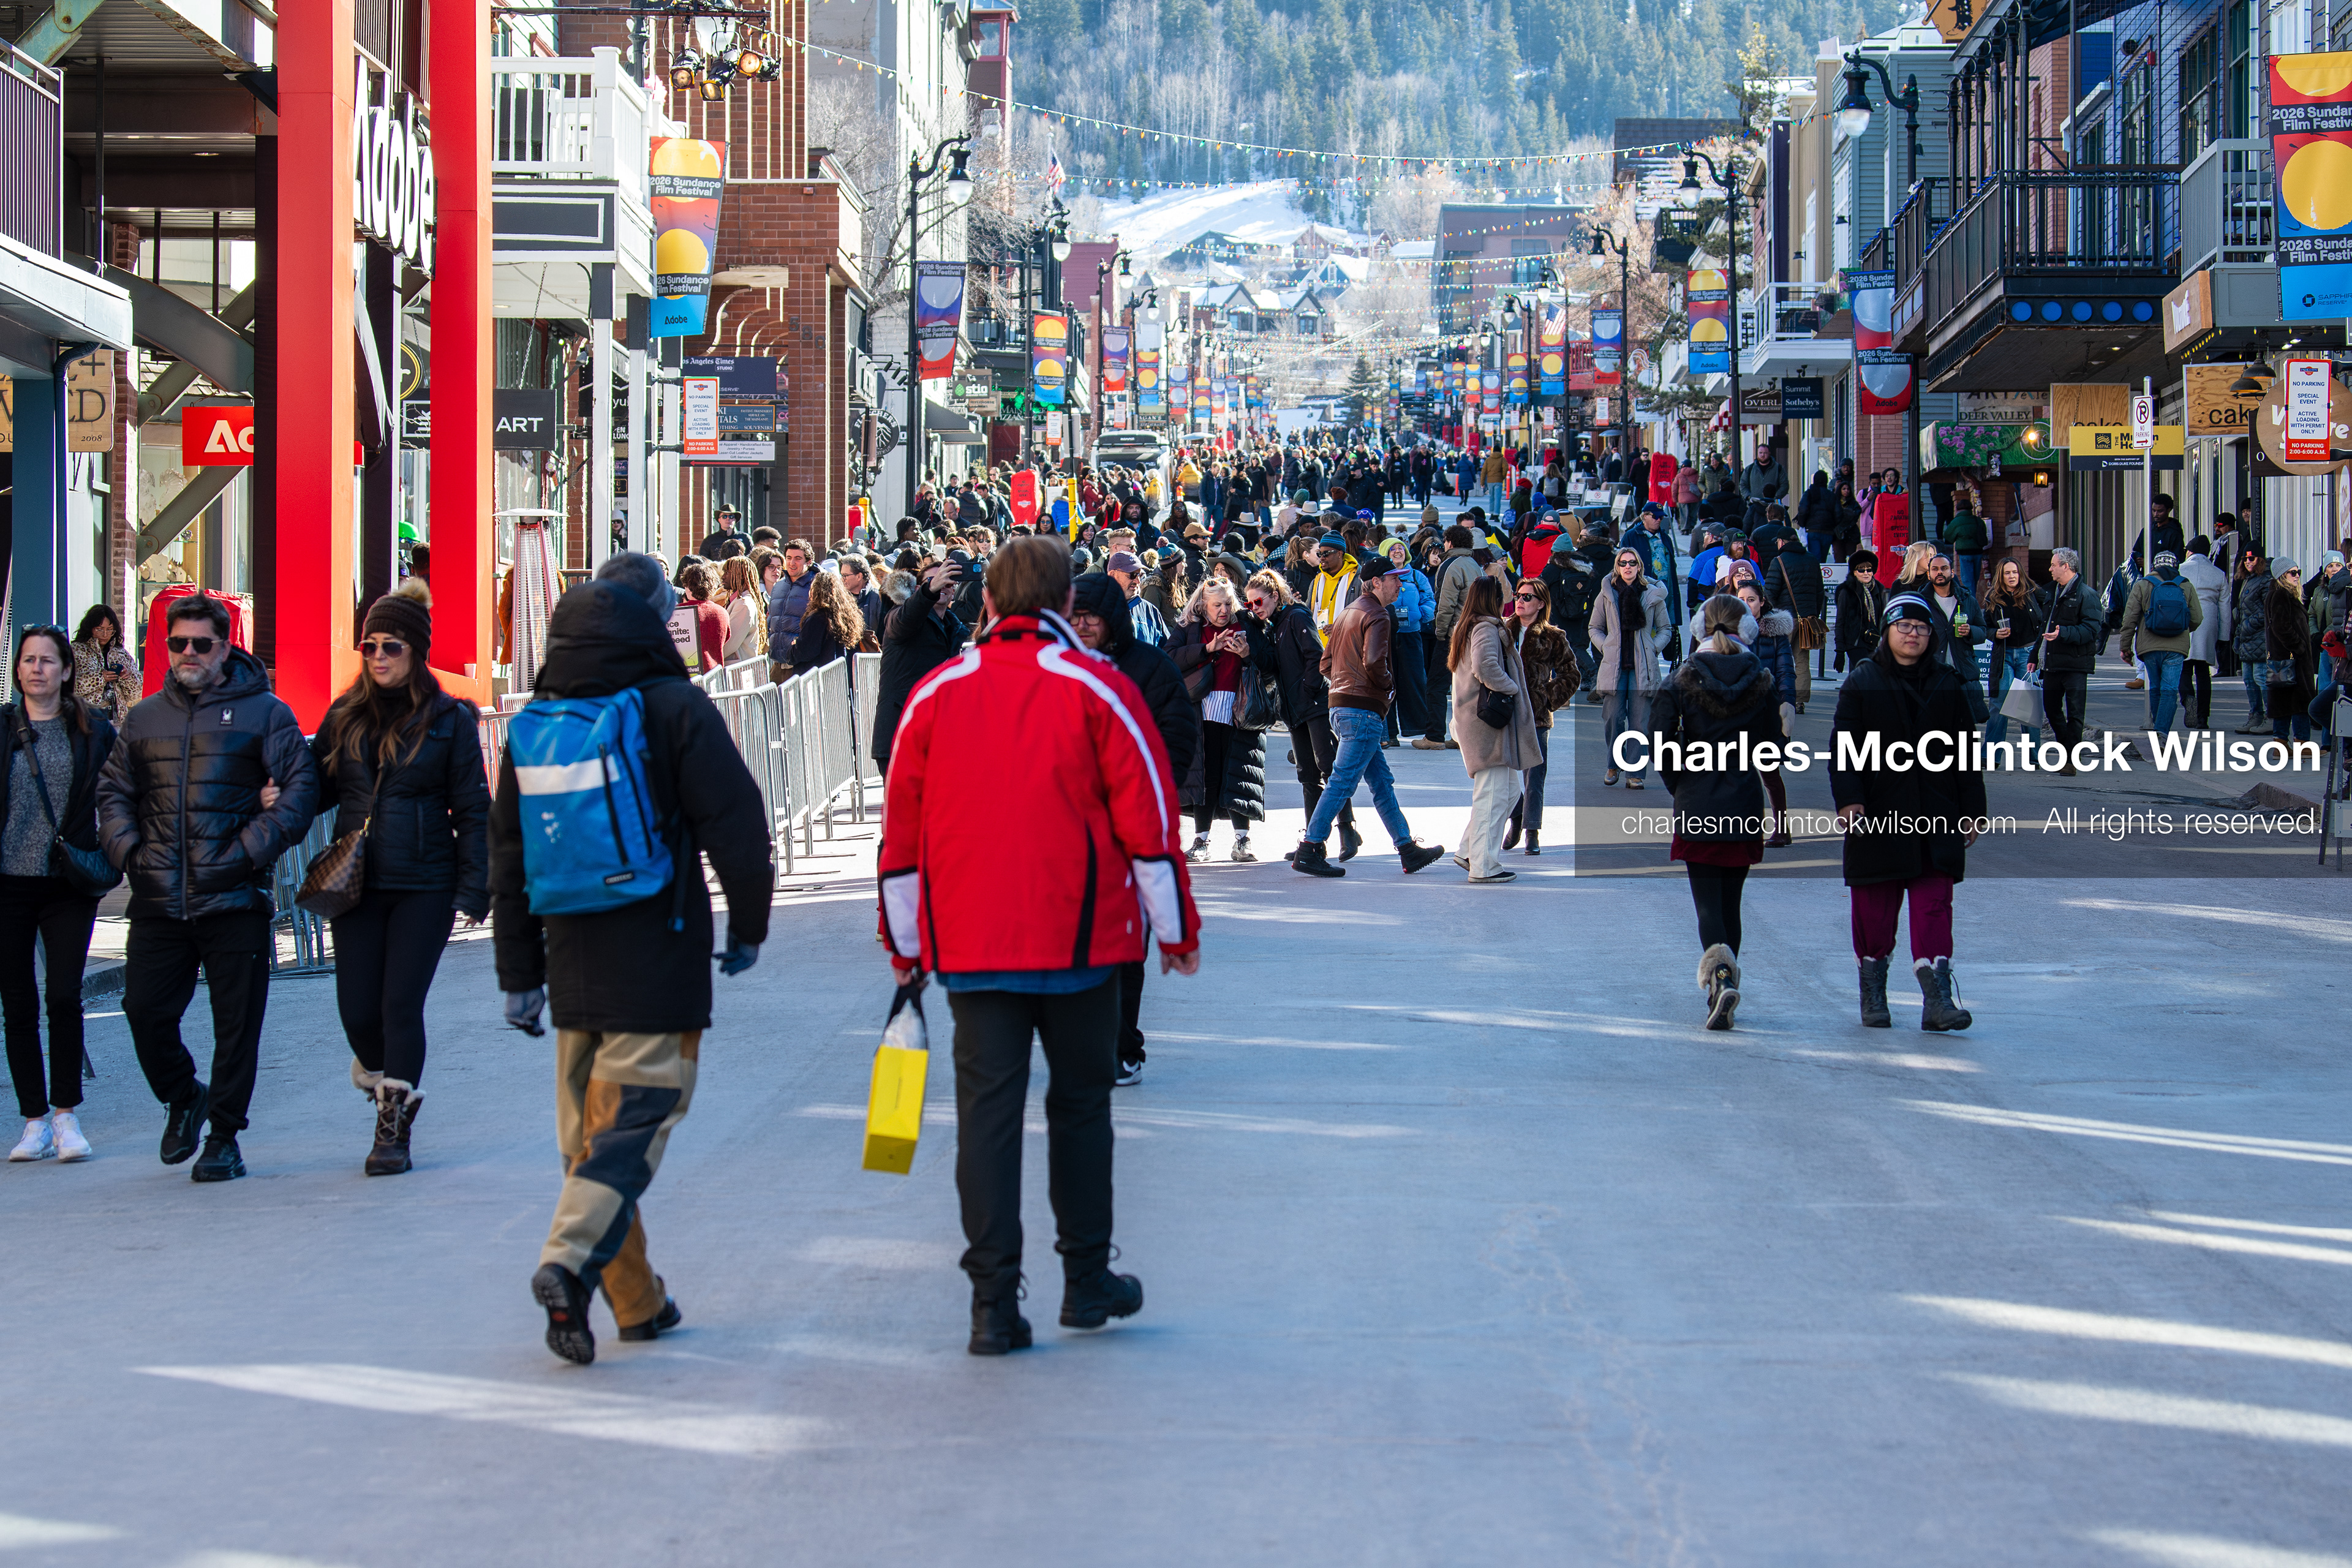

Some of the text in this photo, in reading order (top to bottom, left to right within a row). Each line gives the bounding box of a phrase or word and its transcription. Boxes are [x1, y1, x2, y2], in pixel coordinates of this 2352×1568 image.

[2272, 107, 2305, 120] 2026
[2283, 119, 2311, 131] Film
[650, 176, 721, 189] 2026 Sundance
[655, 185, 713, 196] Film Festival
[2279, 239, 2312, 252] 2026
[2290, 251, 2318, 263] Film
[657, 275, 709, 285] 26 Sundance
[669, 284, 701, 293] Festival
[664, 315, 688, 325] Adobe
[966, 383, 989, 394] stio
[1785, 398, 1820, 407] Sotheby's
[1959, 410, 2031, 421] DEER VALLEY
[2209, 404, 2250, 424] cak
[496, 417, 543, 432] ART
